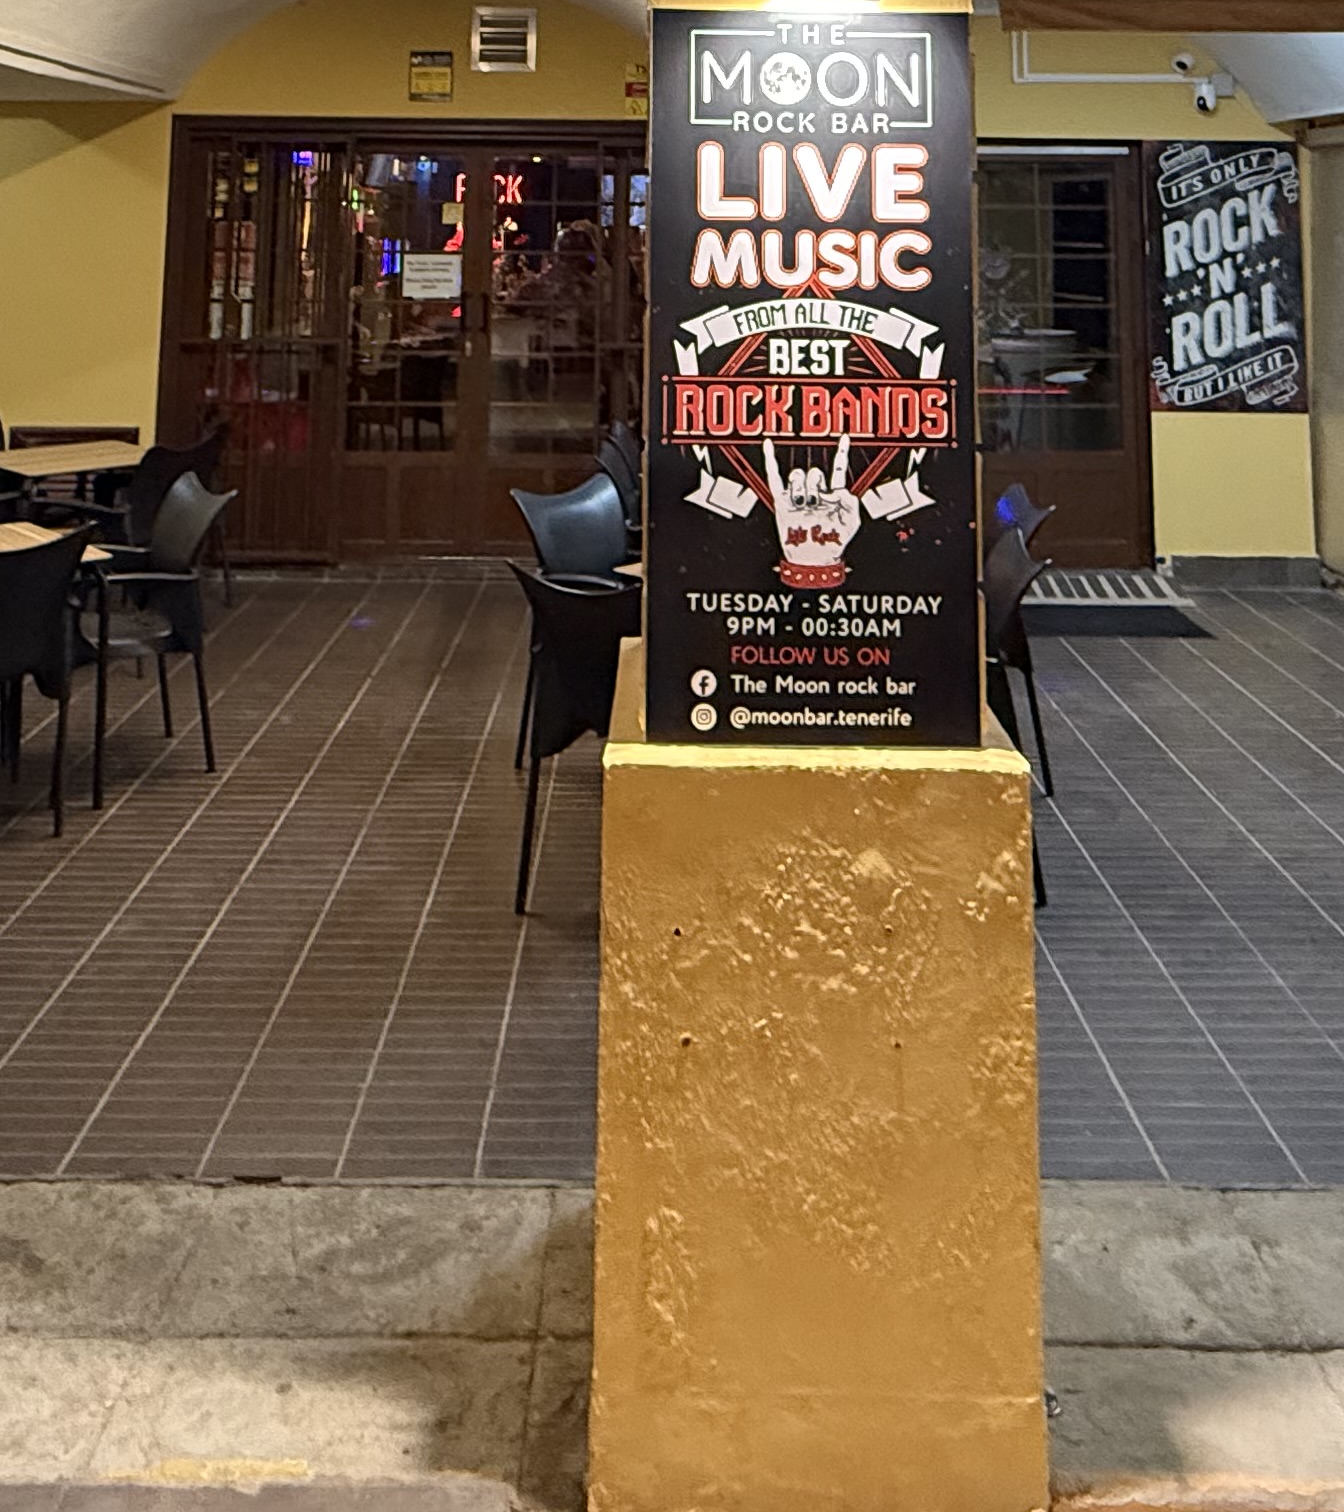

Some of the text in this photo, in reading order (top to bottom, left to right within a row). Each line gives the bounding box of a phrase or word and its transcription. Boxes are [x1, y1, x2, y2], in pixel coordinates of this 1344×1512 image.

[776, 24, 847, 45] THE
[733, 110, 891, 135] ROCK BAR
[697, 140, 931, 224] LIVE
[1209, 153, 1260, 185] ONLY
[1163, 183, 1285, 278] ROCK
[690, 228, 933, 291] MUSIC
[732, 301, 879, 336] FROM ALL THE
[1171, 282, 1297, 372] ROLL
[769, 338, 852, 376] BEST
[1182, 351, 1284, 403] BUT I LIKE IT
[672, 384, 949, 440] ROCK BANDS
[687, 593, 794, 613] TUESDAY
[818, 595, 942, 616] SATURDAY
[726, 617, 775, 636] 9PM
[801, 618, 901, 638] 00:30AM
[731, 645, 890, 666] FOLLOW US ON
[730, 674, 916, 696] The Moon rock bar
[729, 706, 912, 730] @moonbar.tenerife
